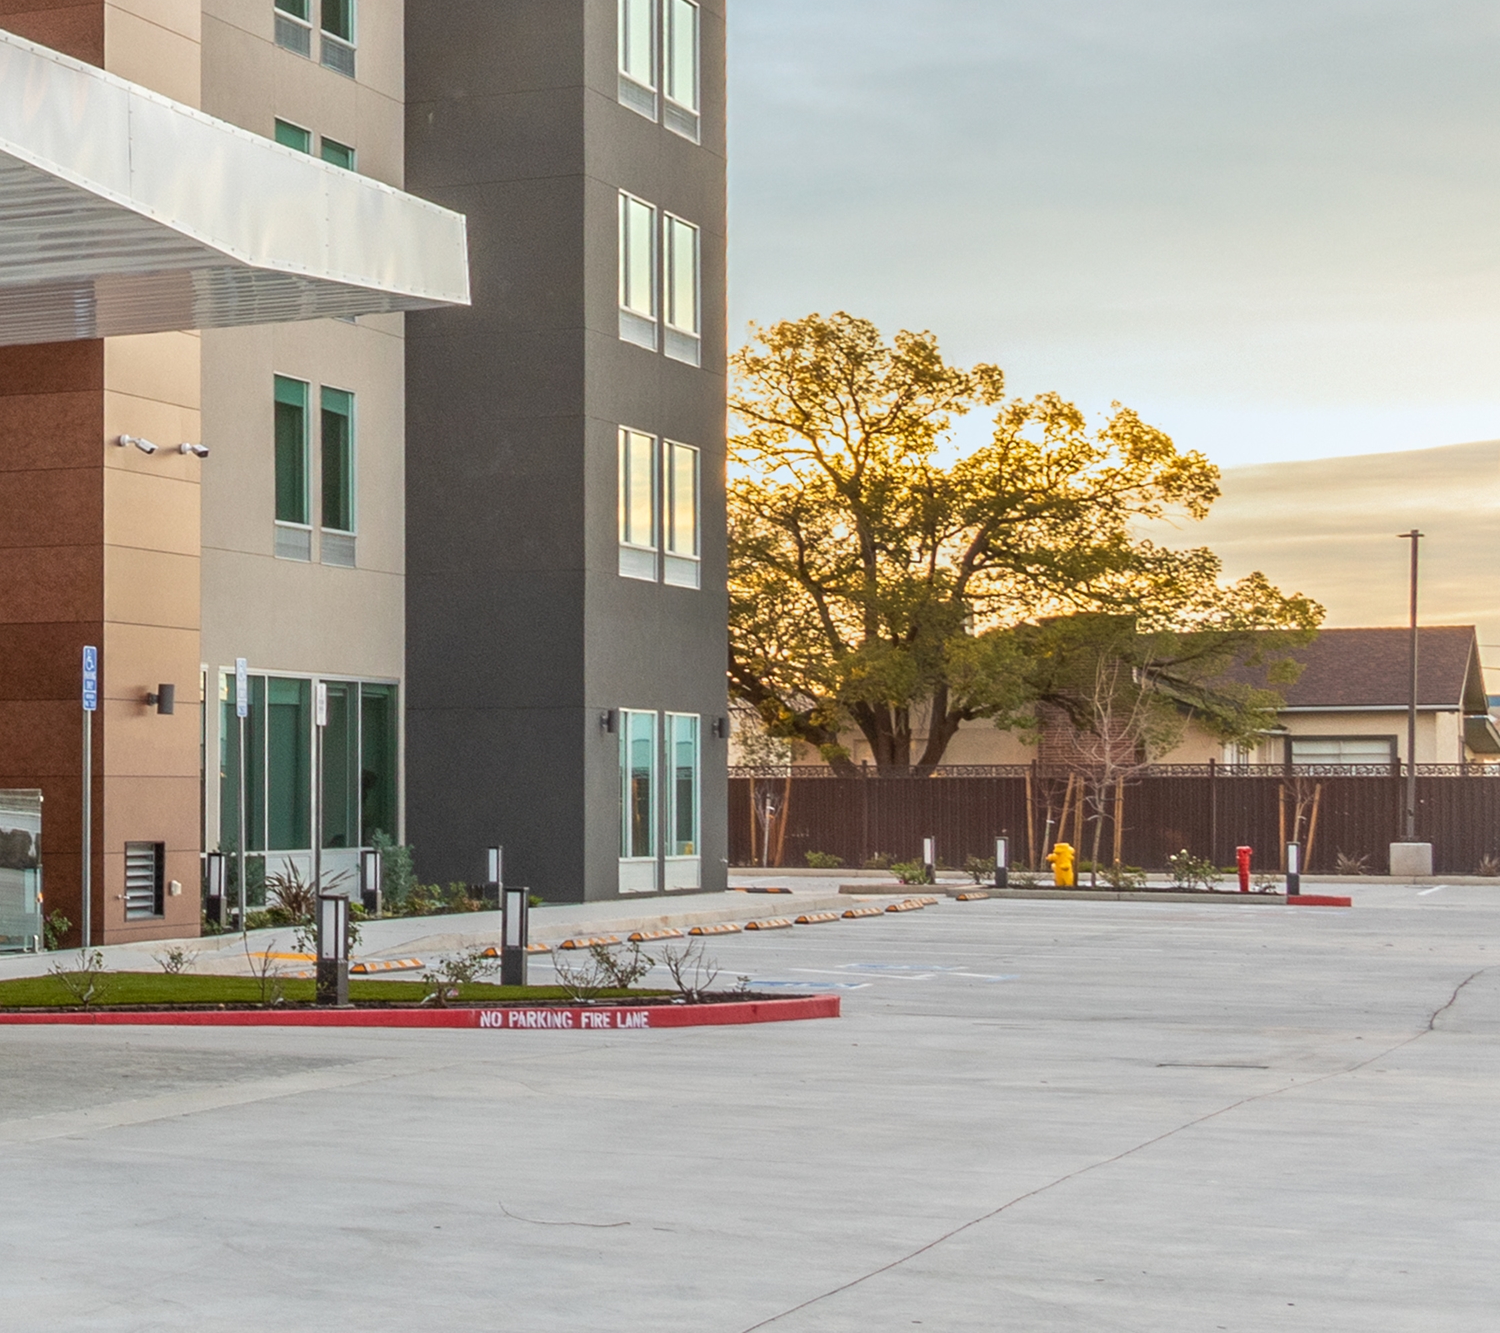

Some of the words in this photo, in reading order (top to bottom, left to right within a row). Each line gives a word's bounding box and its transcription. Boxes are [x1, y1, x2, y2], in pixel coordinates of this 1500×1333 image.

[479, 1010, 502, 1028] NO
[508, 1011, 573, 1028] PARKING
[581, 1011, 612, 1028] FIRE
[616, 1011, 649, 1028] LANE
